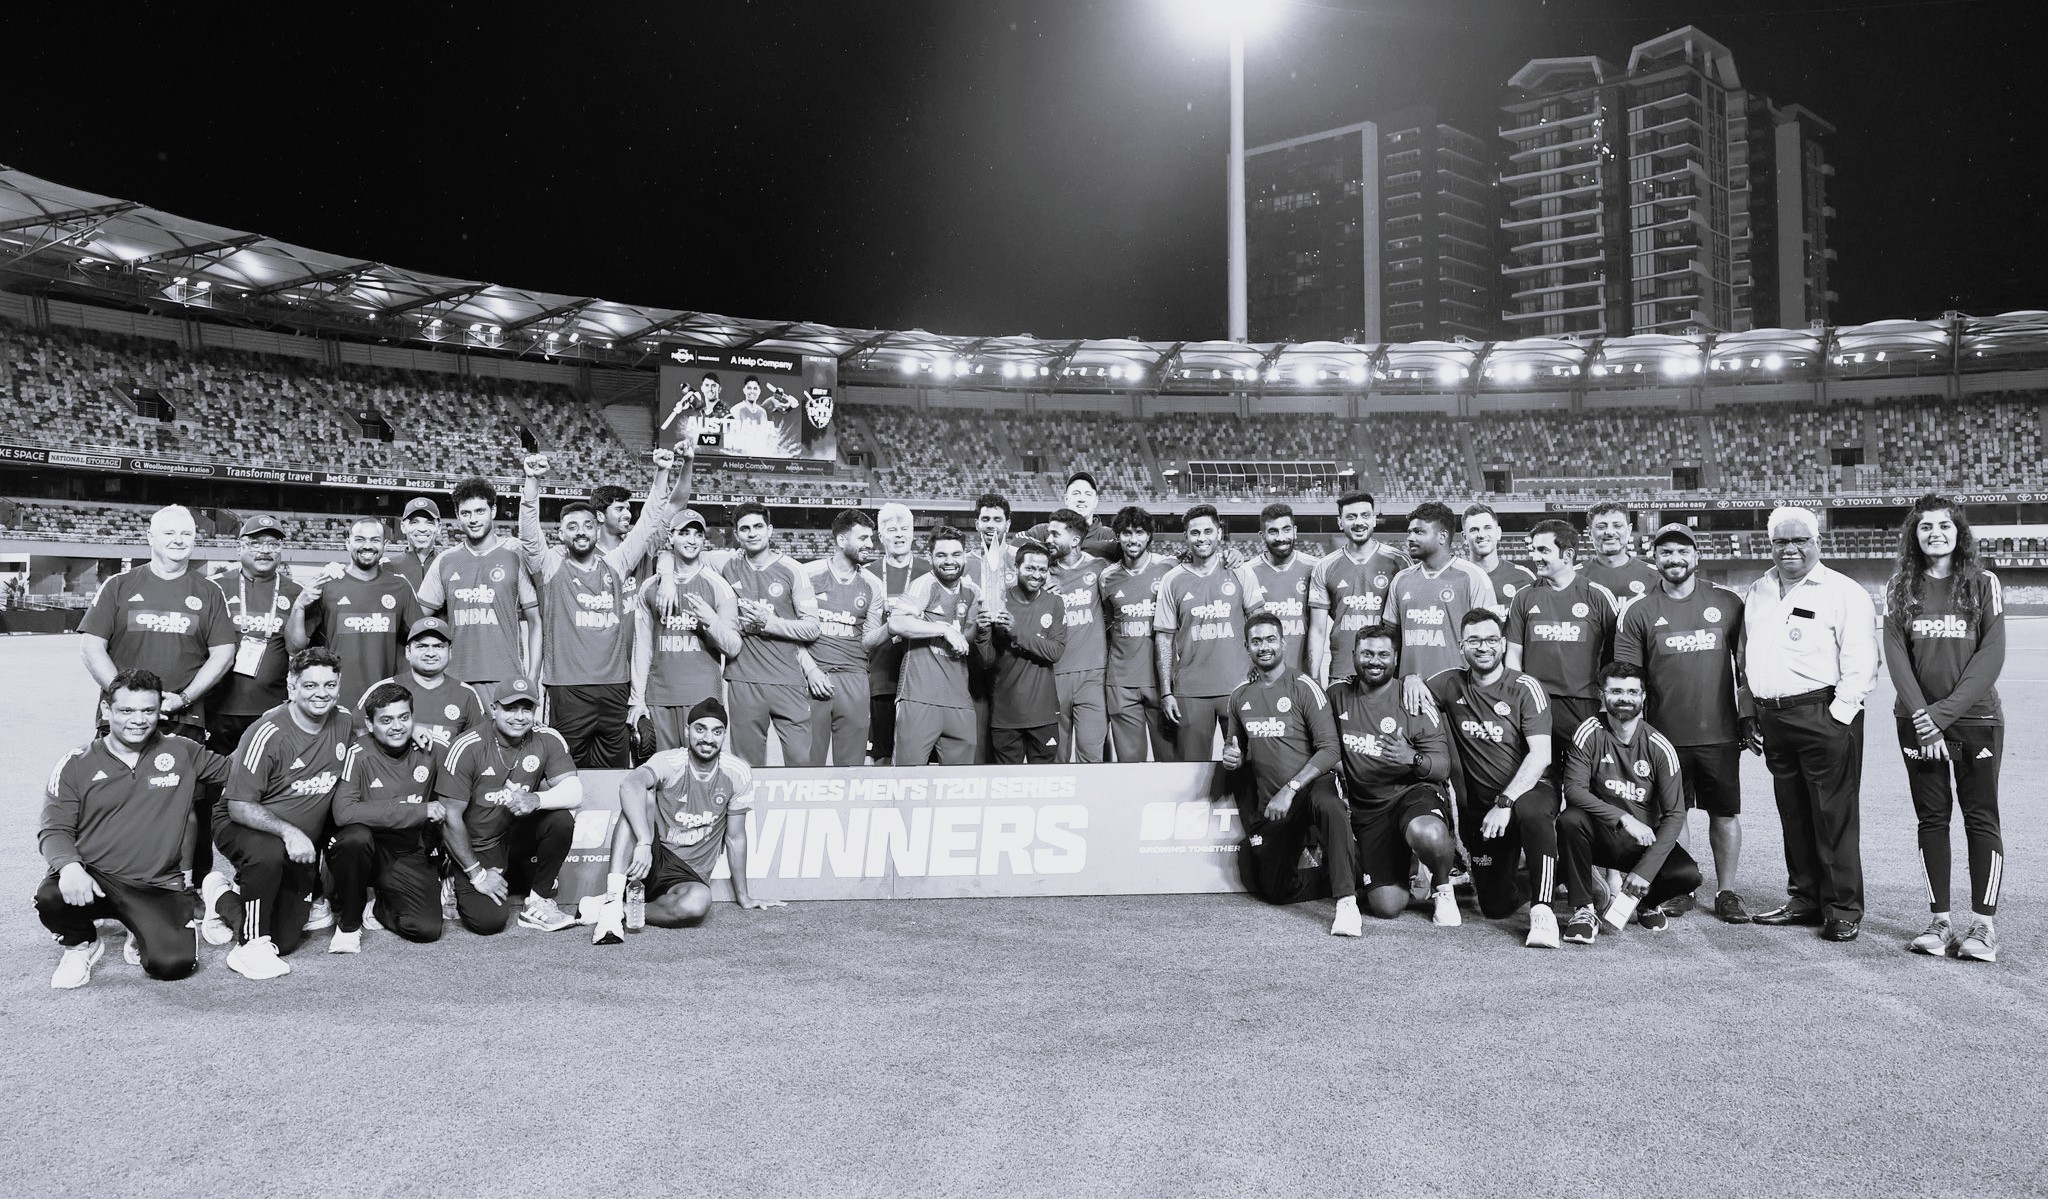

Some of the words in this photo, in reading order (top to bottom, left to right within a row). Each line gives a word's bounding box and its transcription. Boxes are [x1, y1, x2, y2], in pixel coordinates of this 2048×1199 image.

[731, 356, 737, 365] A
[738, 357, 756, 368] Help
[756, 358, 793, 371] Company
[702, 436, 717, 445] VS
[13, 450, 46, 461] SPACE
[50, 454, 85, 464] NATIONAL
[86, 457, 120, 467] STORAGE
[143, 462, 188, 473] Woolloongabba
[189, 466, 210, 474] station
[729, 462, 744, 470] Help
[745, 463, 775, 471] Company
[226, 467, 286, 482] Transforming
[287, 472, 314, 482] travel
[326, 474, 358, 483] bet365
[366, 476, 398, 486] bet365
[405, 478, 436, 488] bet365
[554, 487, 583, 495] bet365
[696, 493, 724, 501] bet365
[731, 495, 757, 503] bet365
[764, 496, 791, 504] bet365
[798, 497, 825, 505] bet365
[831, 498, 858, 506] bet365
[1627, 501, 1649, 509] Match
[1650, 501, 1668, 510] days
[1669, 500, 1688, 508] made
[1689, 501, 1707, 510] easy
[1788, 499, 1823, 507] TOYOTA
[454, 584, 496, 603] apollo
[1343, 592, 1382, 609] apollo
[1191, 600, 1231, 617] apollo
[1263, 598, 1303, 612] apollo
[135, 612, 191, 628] apollo
[233, 613, 283, 628] apolo
[453, 608, 499, 626] INDIA
[576, 611, 620, 628] INDIA
[1406, 606, 1445, 622] apollo
[344, 613, 390, 631] apollo
[1120, 620, 1151, 637] INDI
[1282, 620, 1305, 636] DIA
[1533, 621, 1581, 638] apollo
[1912, 615, 1967, 636] apollo
[1191, 622, 1234, 642] INDIA
[1404, 629, 1446, 647] INDIA
[660, 635, 702, 652] INDIA
[1665, 629, 1717, 651] apollo
[1245, 717, 1286, 736] apollo
[291, 771, 338, 792] apollo
[766, 779, 846, 801] TYRES
[848, 778, 928, 801] MEN'S
[930, 777, 988, 800] T20I
[989, 776, 1076, 799] SERIES
[1604, 779, 1647, 797] apllo
[1139, 845, 1187, 854] GROWING
[1188, 844, 1241, 853] TOGETHER
[582, 854, 611, 863] TOGE
